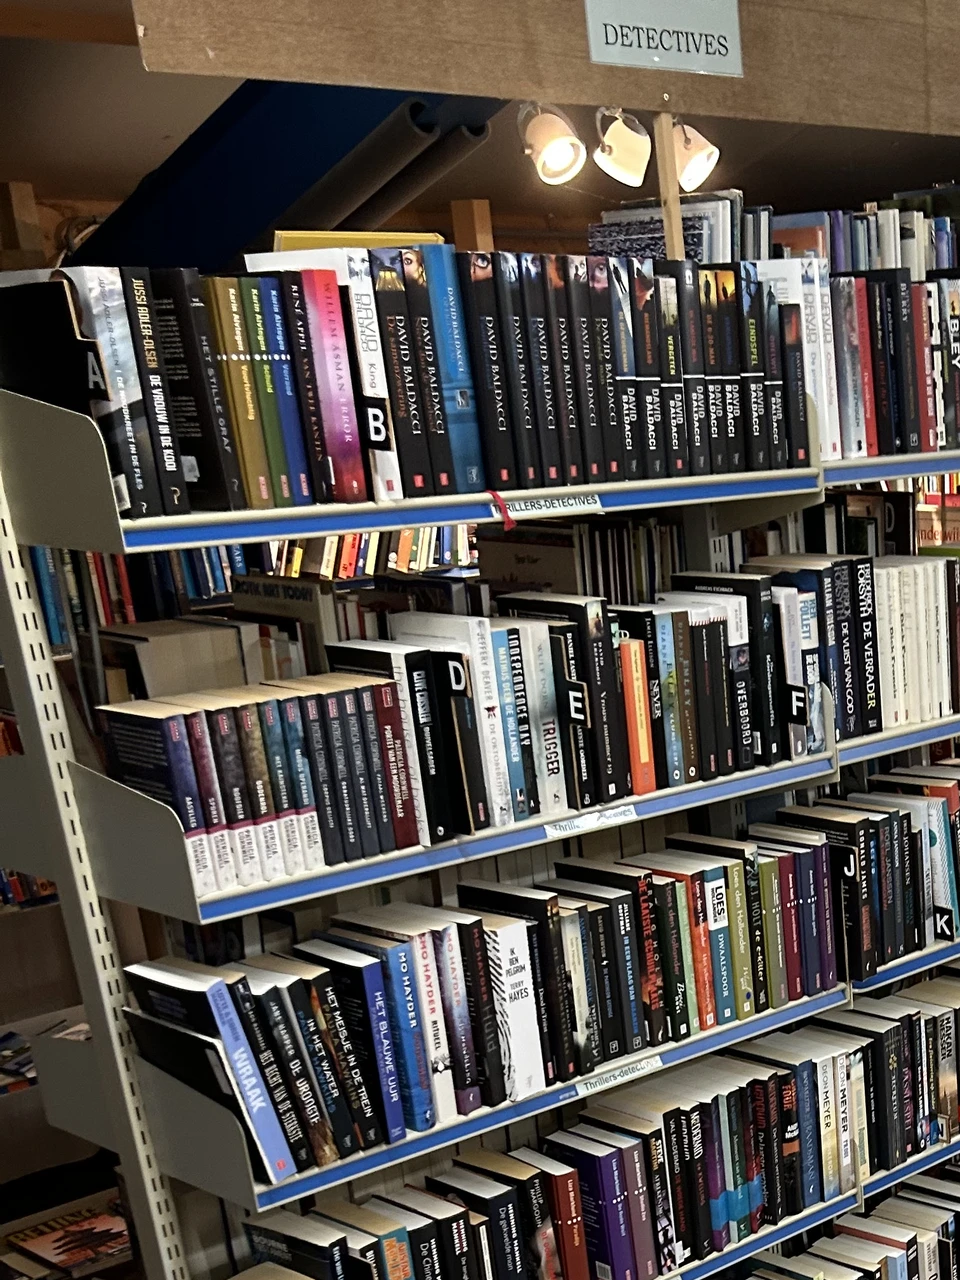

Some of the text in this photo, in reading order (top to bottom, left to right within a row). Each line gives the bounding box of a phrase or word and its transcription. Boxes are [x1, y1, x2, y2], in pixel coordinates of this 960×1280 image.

[603, 22, 730, 57] DETECTIVES
[667, 336, 676, 375] VERGETEN
[749, 318, 758, 367] EINDSPEL
[88, 351, 106, 390] A
[131, 278, 176, 471] JUSSI ADLER-OLSEN DE VROUW IN DE KOOI
[395, 315, 422, 435] DAVID BALDACCI
[485, 316, 507, 431] DAVID BALDACCI
[536, 317, 555, 430] DAVID BALDACCI
[200, 336, 232, 454] HET STILLE GRAF
[627, 388, 637, 422] DAVID
[367, 407, 387, 442] B
[622, 395, 633, 451] BALDACCI
[494, 496, 598, 515] TRILLERS-DETECTIVES
[824, 577, 832, 608] ALLAN
[800, 600, 811, 640] FOLLETT
[840, 622, 849, 636] DE
[448, 661, 465, 690] D
[477, 631, 492, 701] JEFFERY DEAVER
[862, 621, 876, 709] DE VERRADER
[569, 691, 585, 720] E
[736, 681, 752, 745] OVERBOORD
[792, 690, 804, 716] F
[519, 724, 531, 746] DAY
[542, 718, 560, 777] TRIGGER
[208, 798, 219, 824] SPOREN
[844, 854, 855, 877] J
[860, 869, 868, 900] JAMES
[714, 885, 726, 916] LOES
[732, 867, 745, 954] Loes den Hollander
[936, 913, 950, 935] K
[505, 964, 526, 978] PELGRIM
[508, 957, 519, 967] BEN
[509, 947, 516, 957] IK
[717, 933, 729, 998] DWAALSPOOR
[398, 952, 417, 1029] MO HAYDER
[508, 989, 529, 1003] HAYES
[510, 980, 524, 991] TERRY
[423, 963, 436, 1015] HAYDER
[431, 1020, 442, 1051] RITUEEL
[288, 1057, 300, 1075] DE
[306, 1018, 340, 1100] IN HET WATER
[324, 986, 374, 1119] HET MEISJE IN DE TREIN
[374, 992, 399, 1103] HET BLAUWE UUR
[232, 1047, 266, 1114] WRAAK
[823, 1091, 832, 1130] MEYER
[839, 1087, 849, 1134] MEYER
[529, 1189, 542, 1228] MARGOLIN
[533, 1179, 543, 1204] PHILLIP
[420, 1243, 429, 1257] De
[430, 1238, 441, 1274] HENNING
